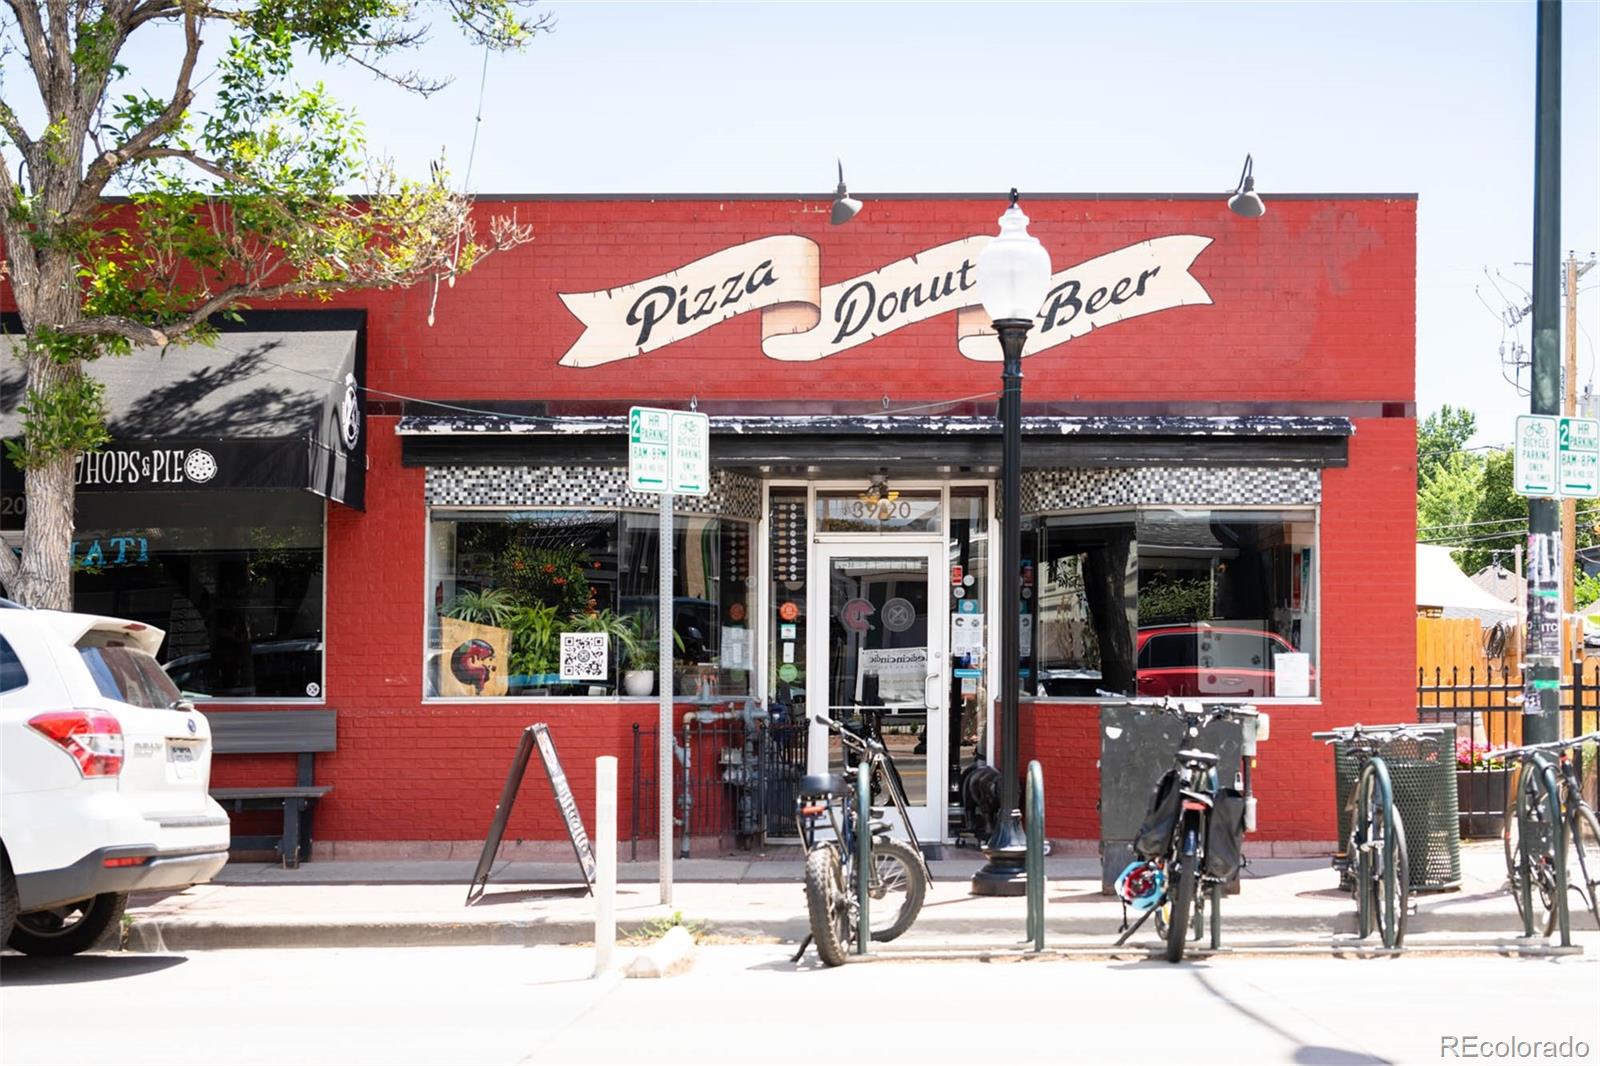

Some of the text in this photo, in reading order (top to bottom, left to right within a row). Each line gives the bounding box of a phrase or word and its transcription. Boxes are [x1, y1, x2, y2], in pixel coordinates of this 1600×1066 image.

[626, 259, 1161, 346] Pizza Donut Beer
[632, 415, 640, 437] 2
[641, 428, 668, 442] PARKING
[1560, 424, 1569, 445] 2
[1569, 436, 1597, 448] PARKING
